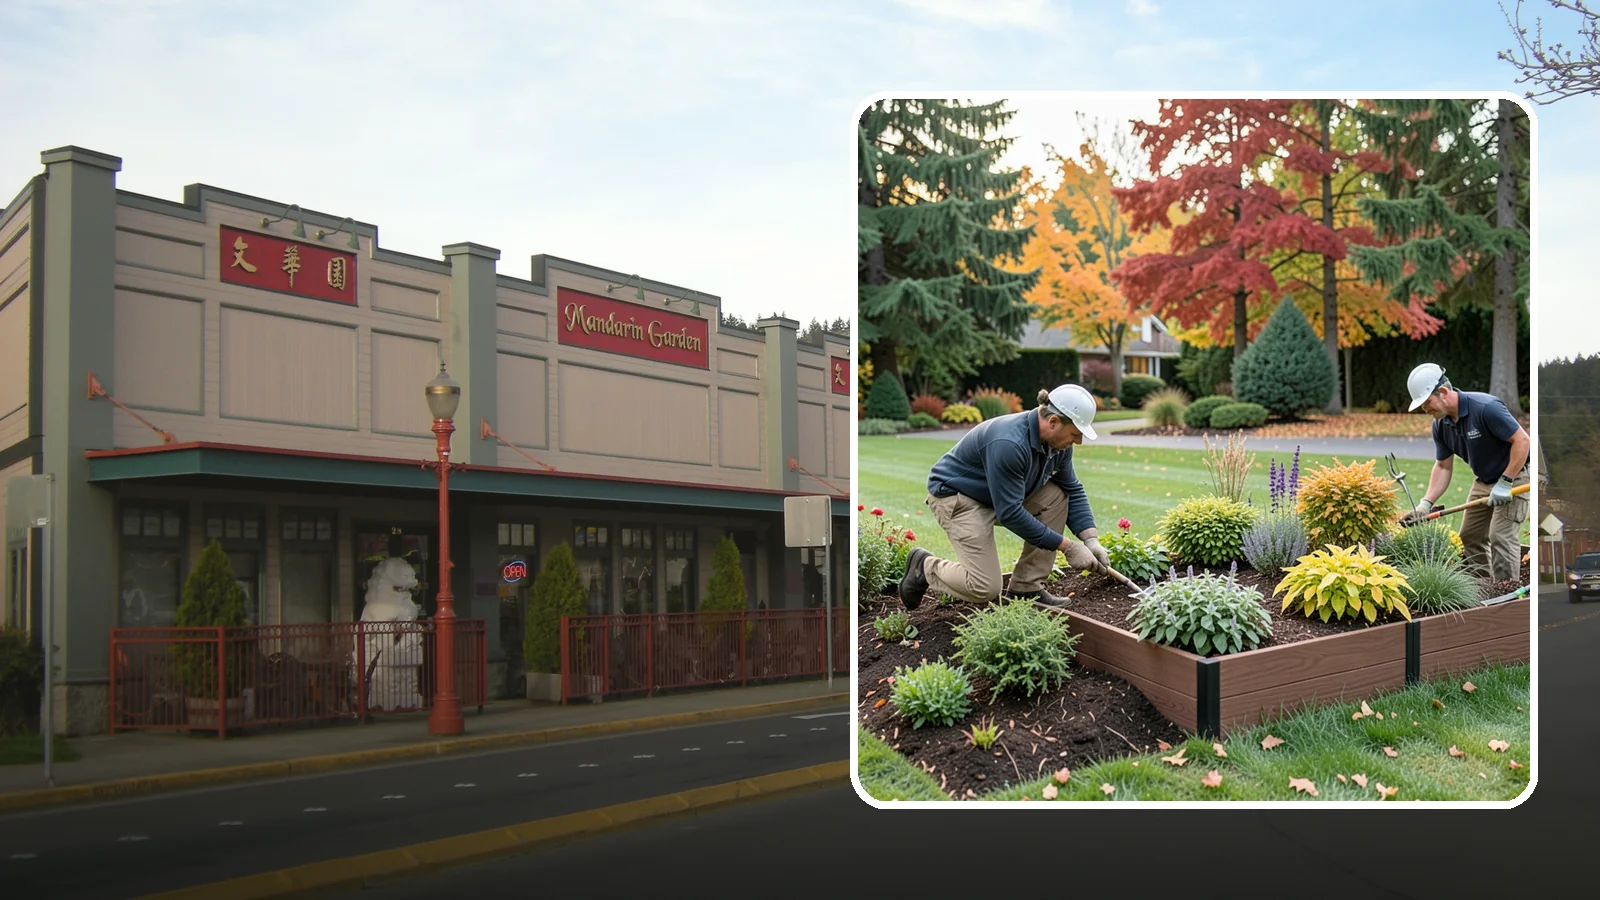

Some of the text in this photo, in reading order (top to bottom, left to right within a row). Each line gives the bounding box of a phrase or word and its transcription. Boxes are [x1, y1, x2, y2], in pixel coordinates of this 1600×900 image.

[564, 302, 701, 352] Mandarin Garden
[503, 565, 526, 577] OPEN
